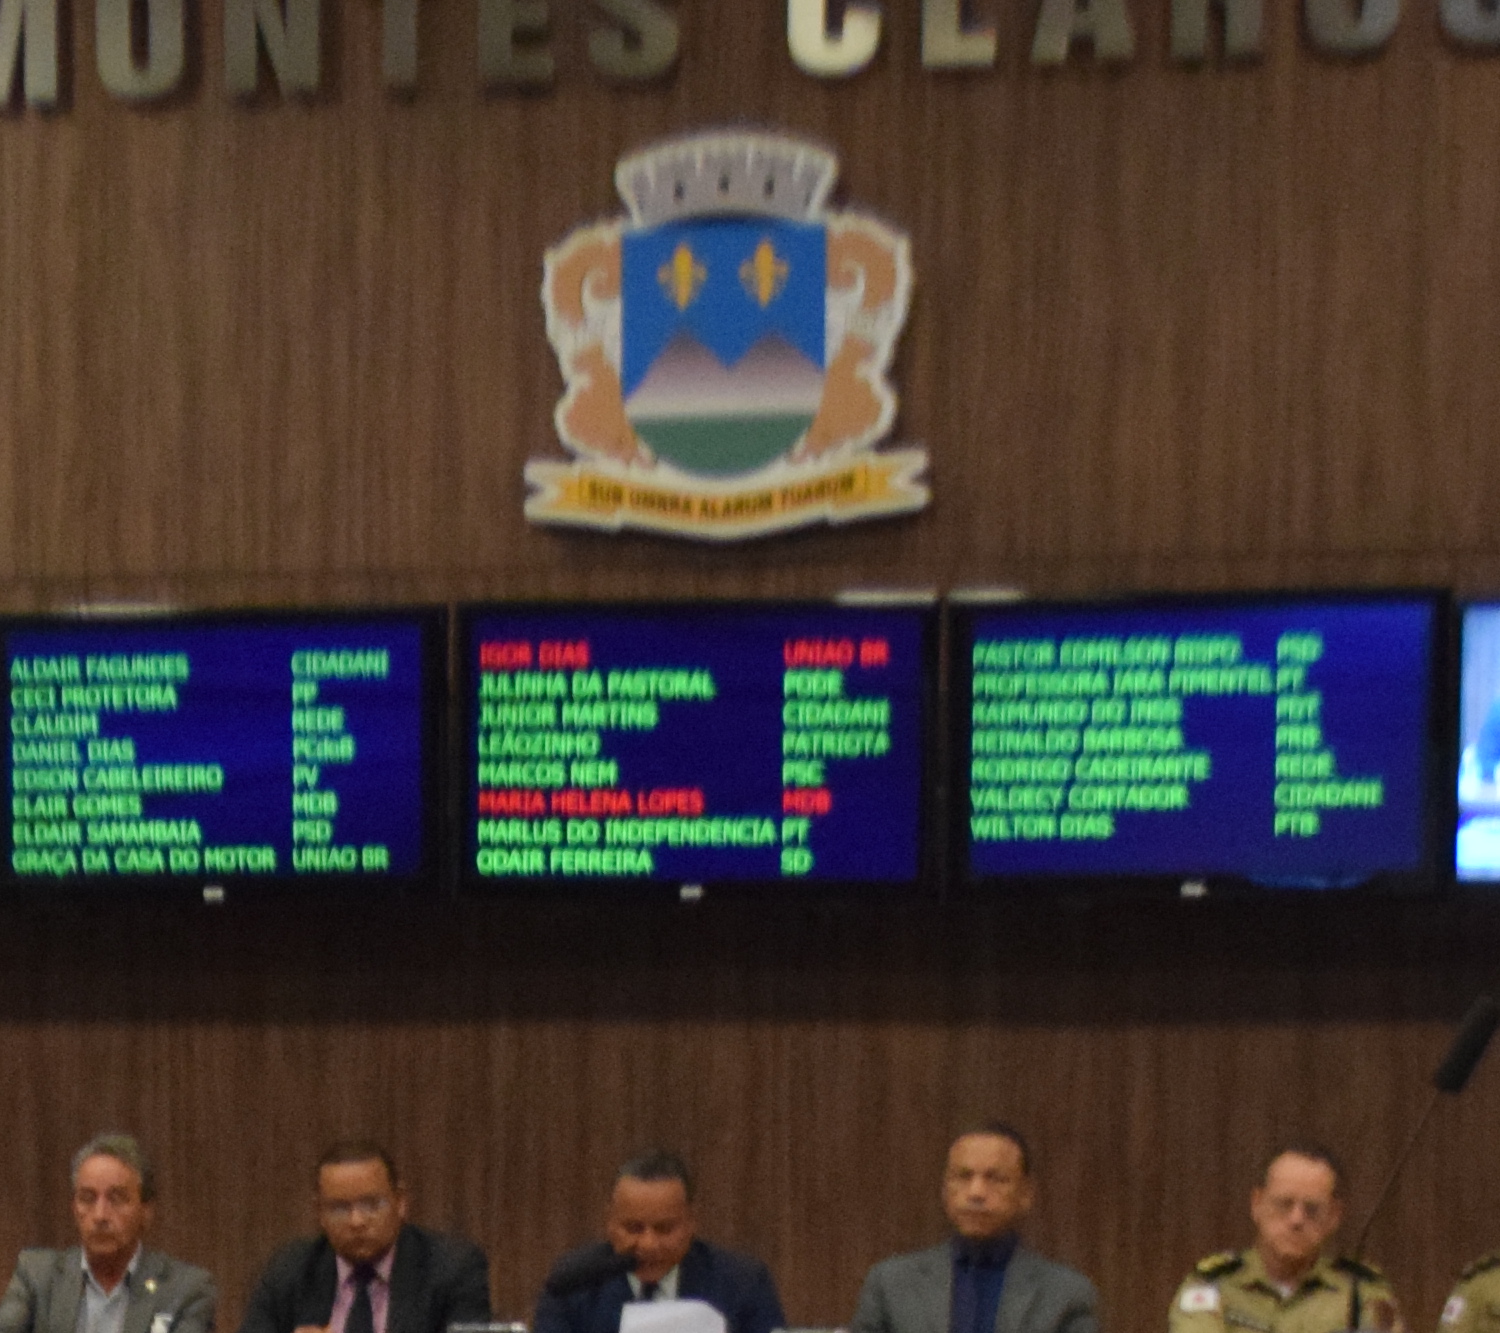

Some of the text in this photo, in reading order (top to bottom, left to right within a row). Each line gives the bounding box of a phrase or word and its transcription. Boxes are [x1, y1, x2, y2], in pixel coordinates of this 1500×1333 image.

[12, 739, 80, 765] DANIEL
[87, 737, 136, 764] DIAS
[478, 759, 566, 788] MARCOS
[566, 817, 600, 846] DO
[605, 817, 777, 847] INDEPENDENCIA
[204, 845, 277, 874] MOTOR
